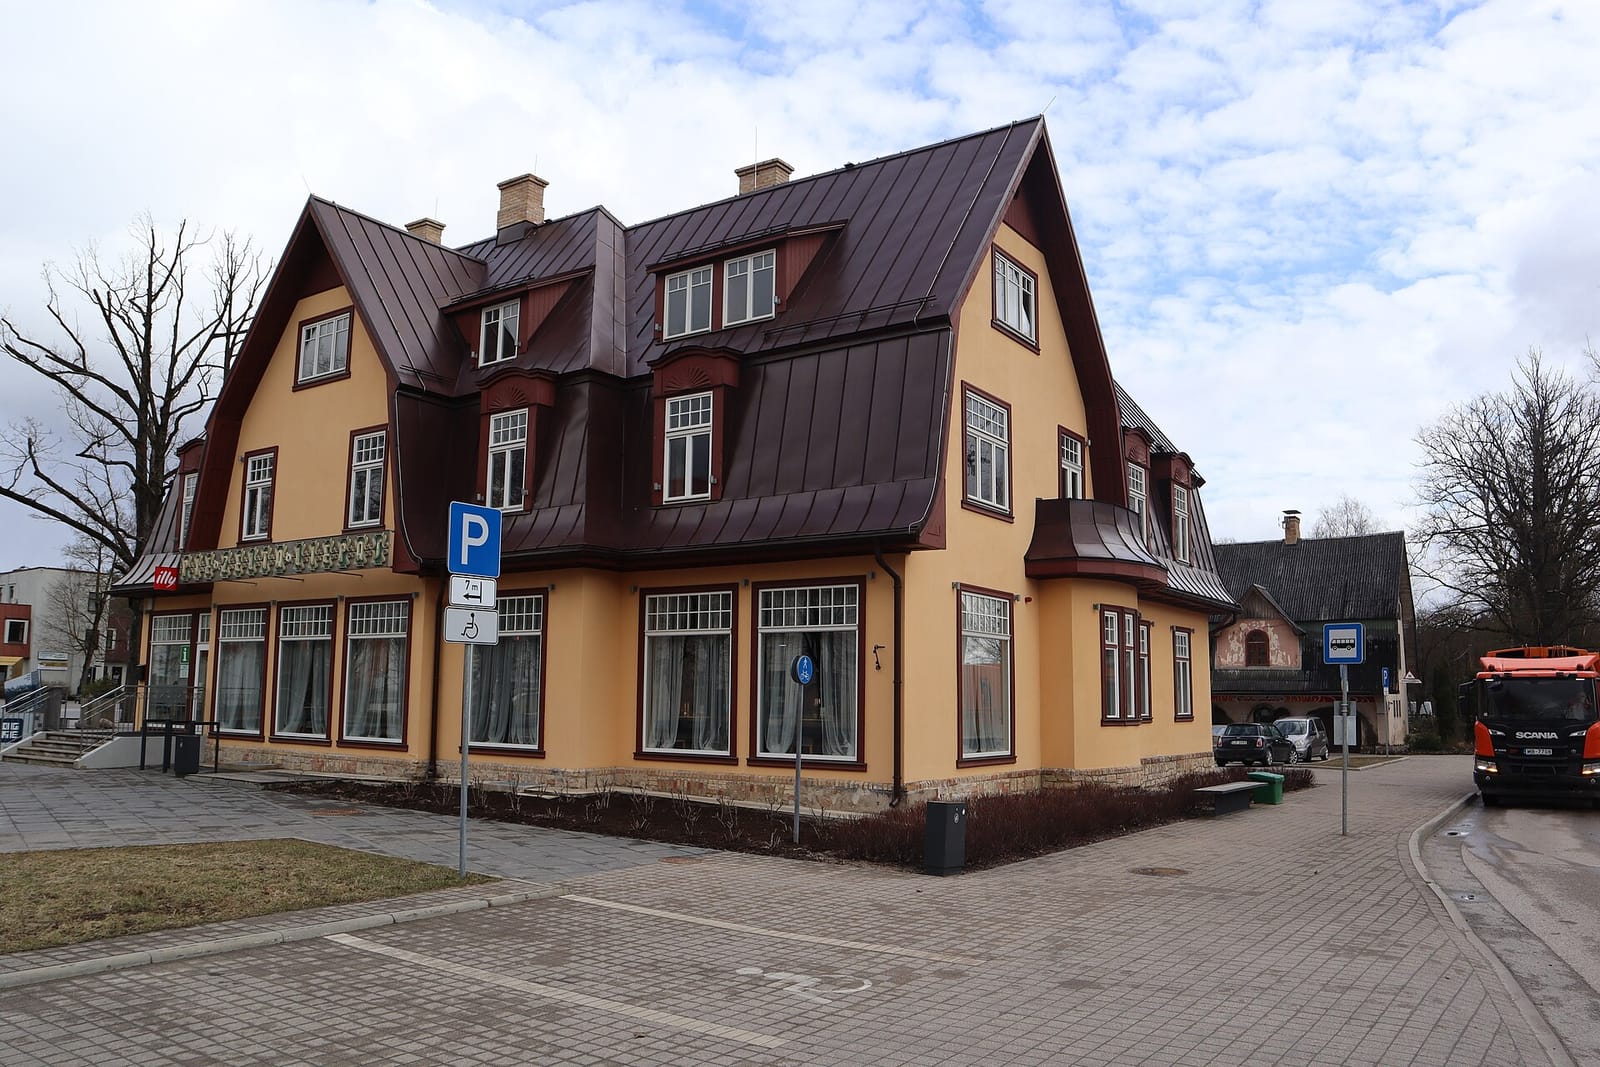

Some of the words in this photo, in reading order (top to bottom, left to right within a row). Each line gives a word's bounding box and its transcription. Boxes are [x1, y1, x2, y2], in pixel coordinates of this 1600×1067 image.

[461, 513, 489, 565] P
[156, 570, 177, 588] illy
[465, 580, 471, 590] 7
